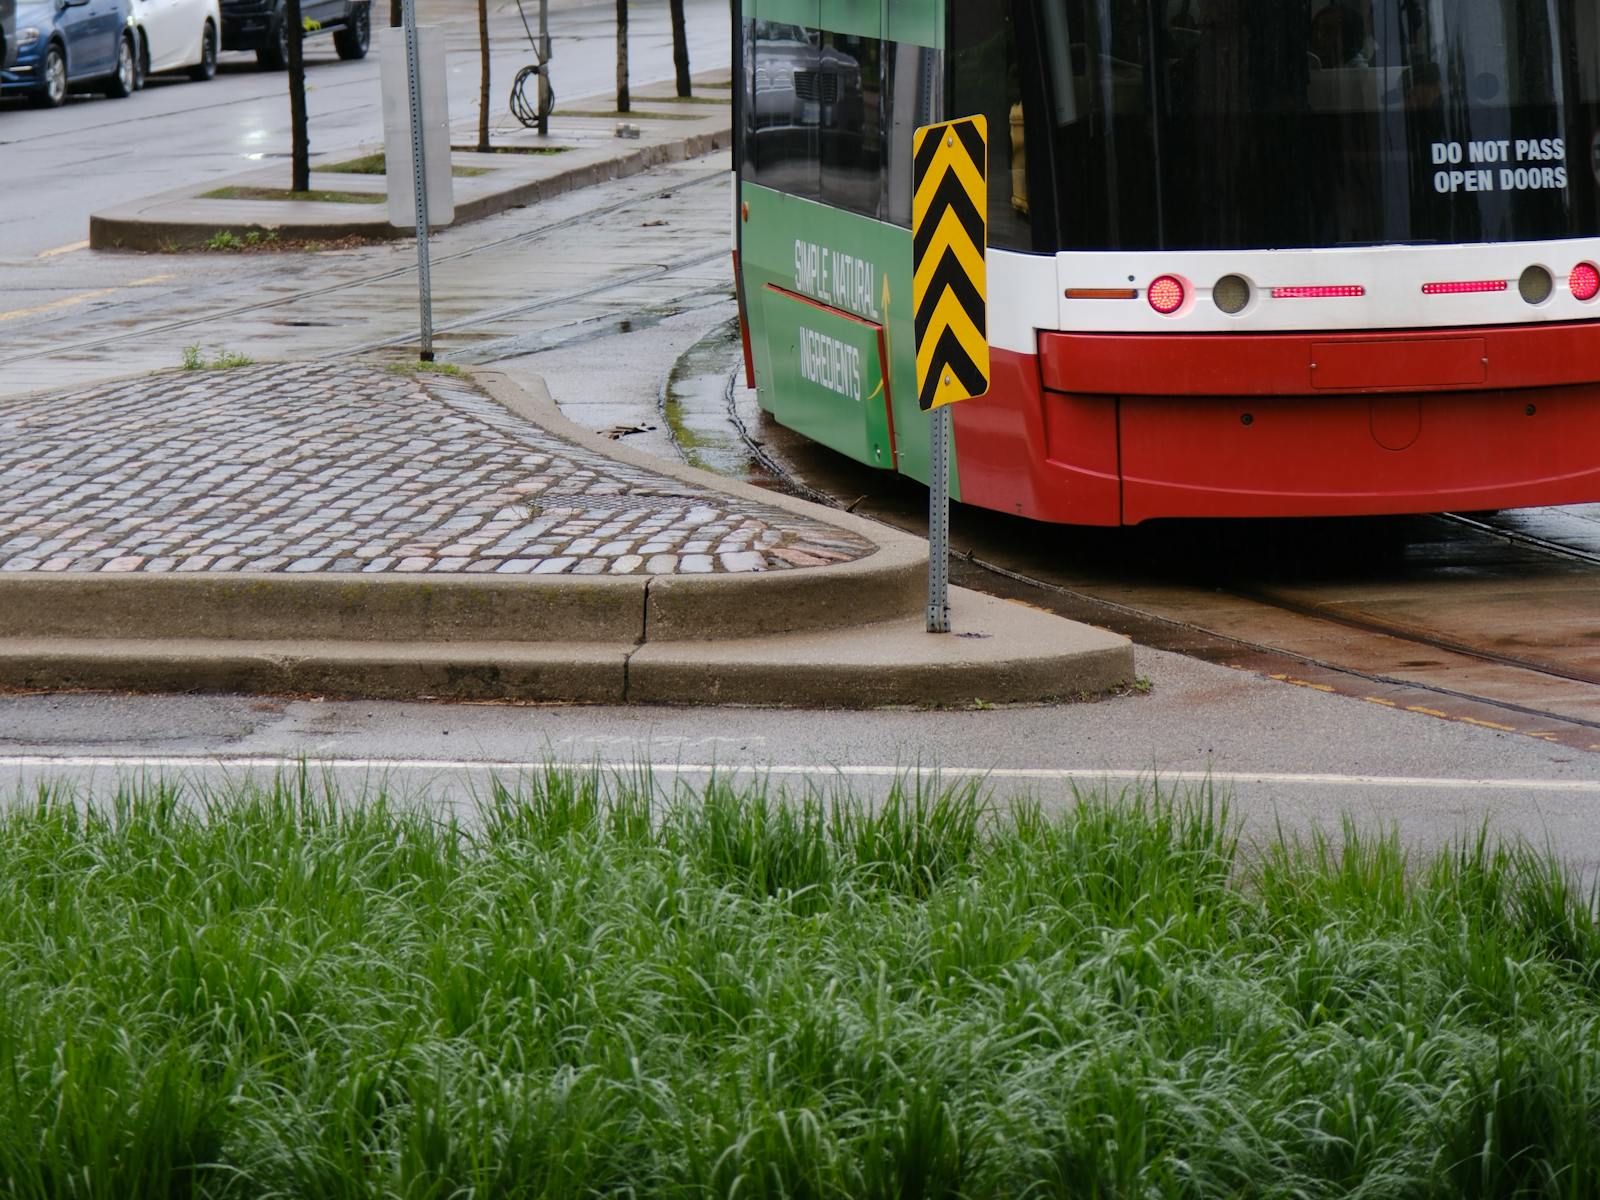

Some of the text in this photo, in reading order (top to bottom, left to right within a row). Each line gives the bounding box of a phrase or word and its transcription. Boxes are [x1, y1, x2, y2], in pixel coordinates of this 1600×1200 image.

[1431, 138, 1566, 165] DO NOT PASS
[1434, 167, 1568, 193] OPEN DOORS
[832, 250, 879, 319] NATURAL
[799, 326, 861, 401] INGREDIENTS
